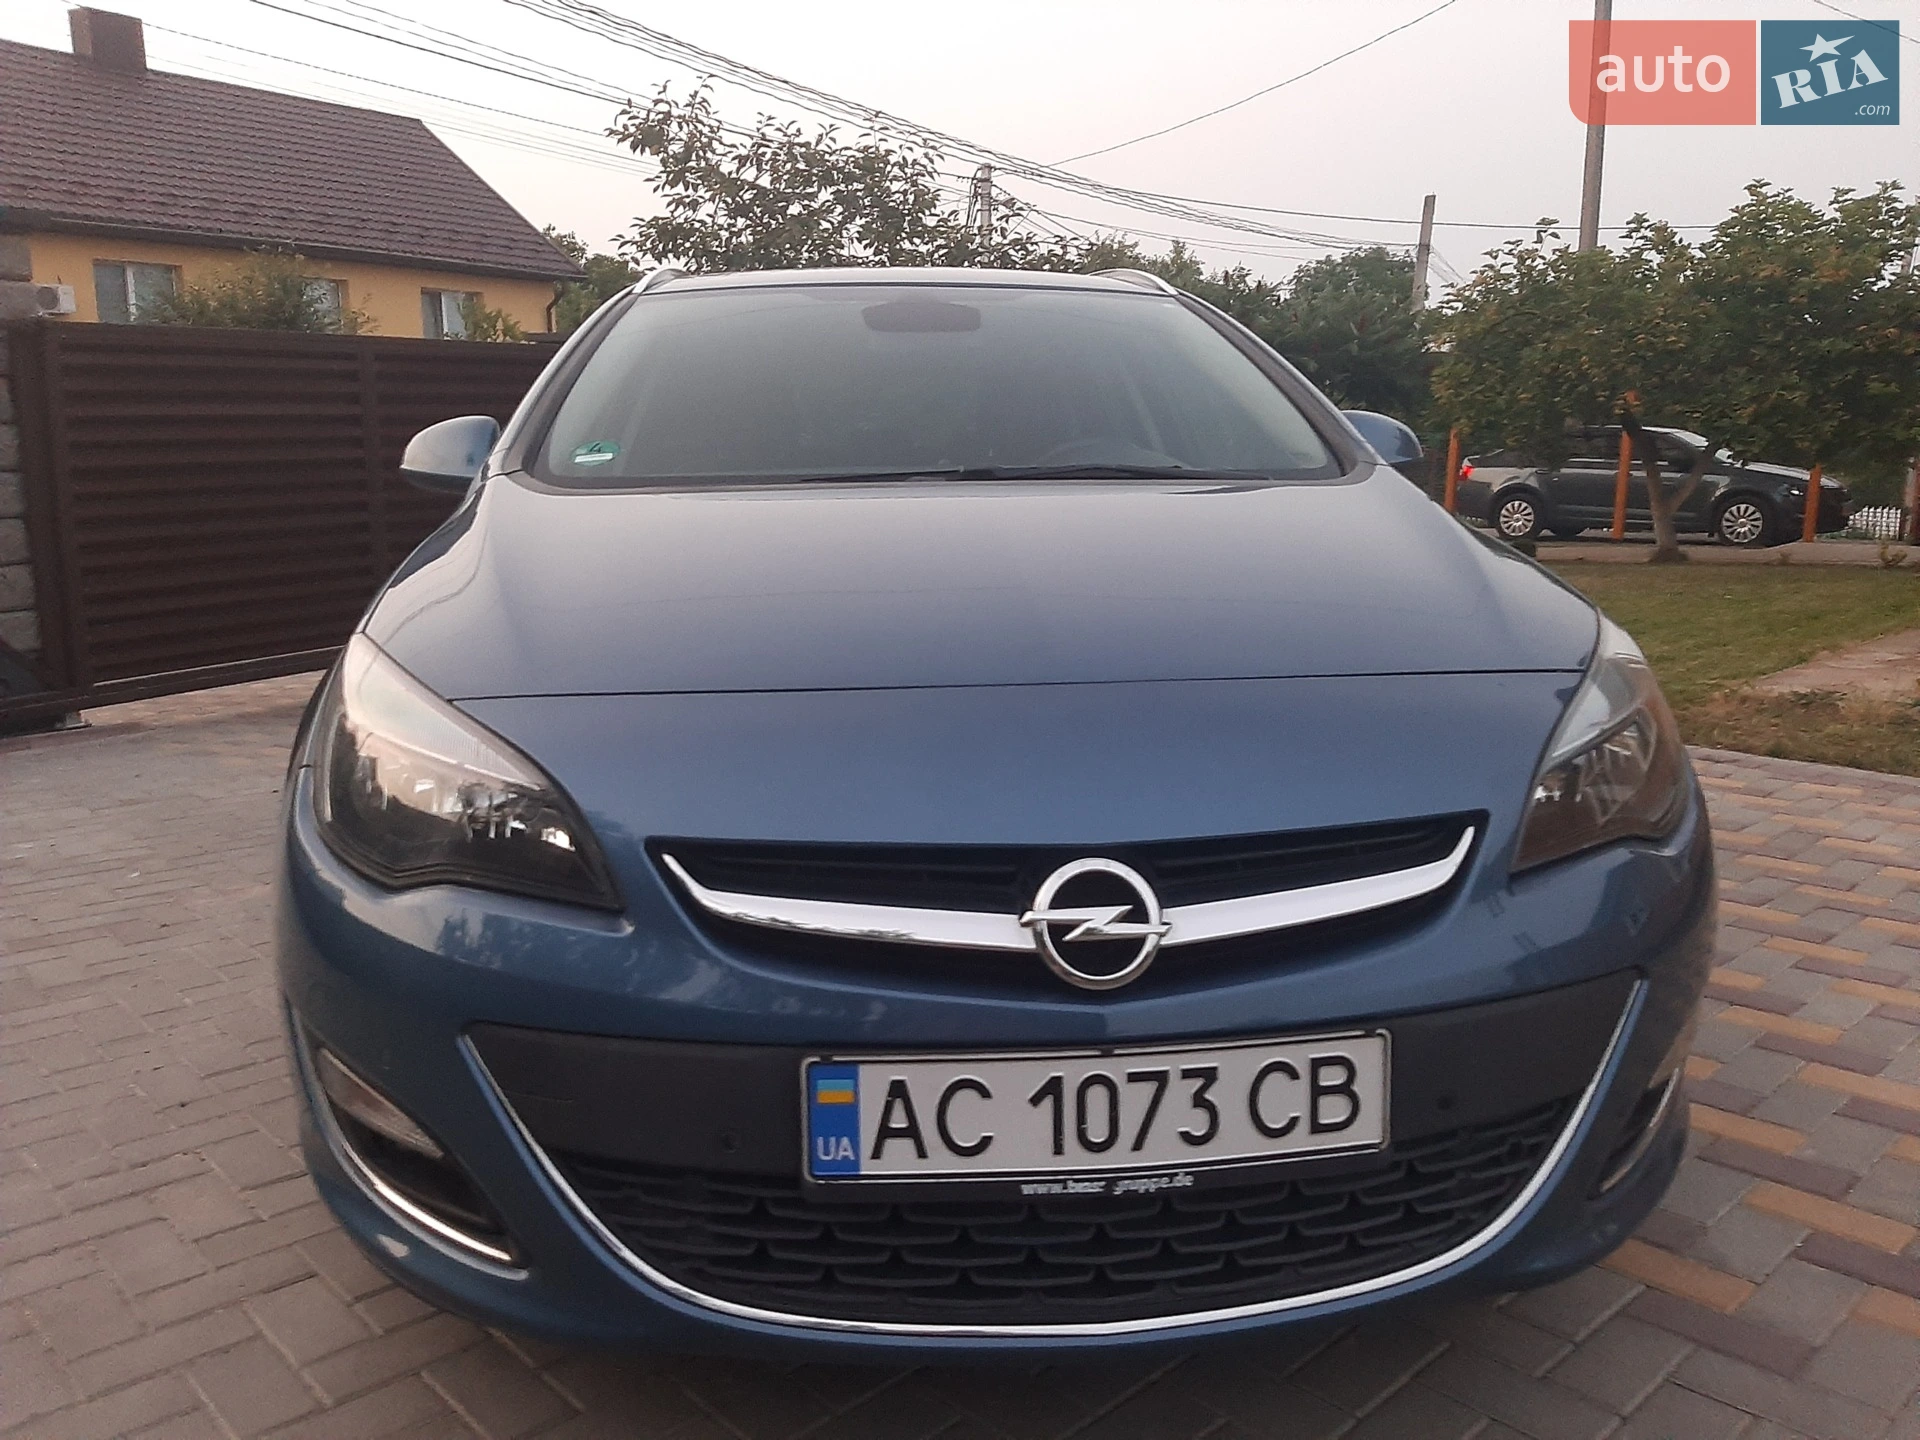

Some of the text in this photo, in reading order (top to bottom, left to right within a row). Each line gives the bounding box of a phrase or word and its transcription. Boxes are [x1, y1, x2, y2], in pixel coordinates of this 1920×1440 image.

[870, 1054, 1360, 1161] AC 1073 CB
[817, 1136, 855, 1161] UA
